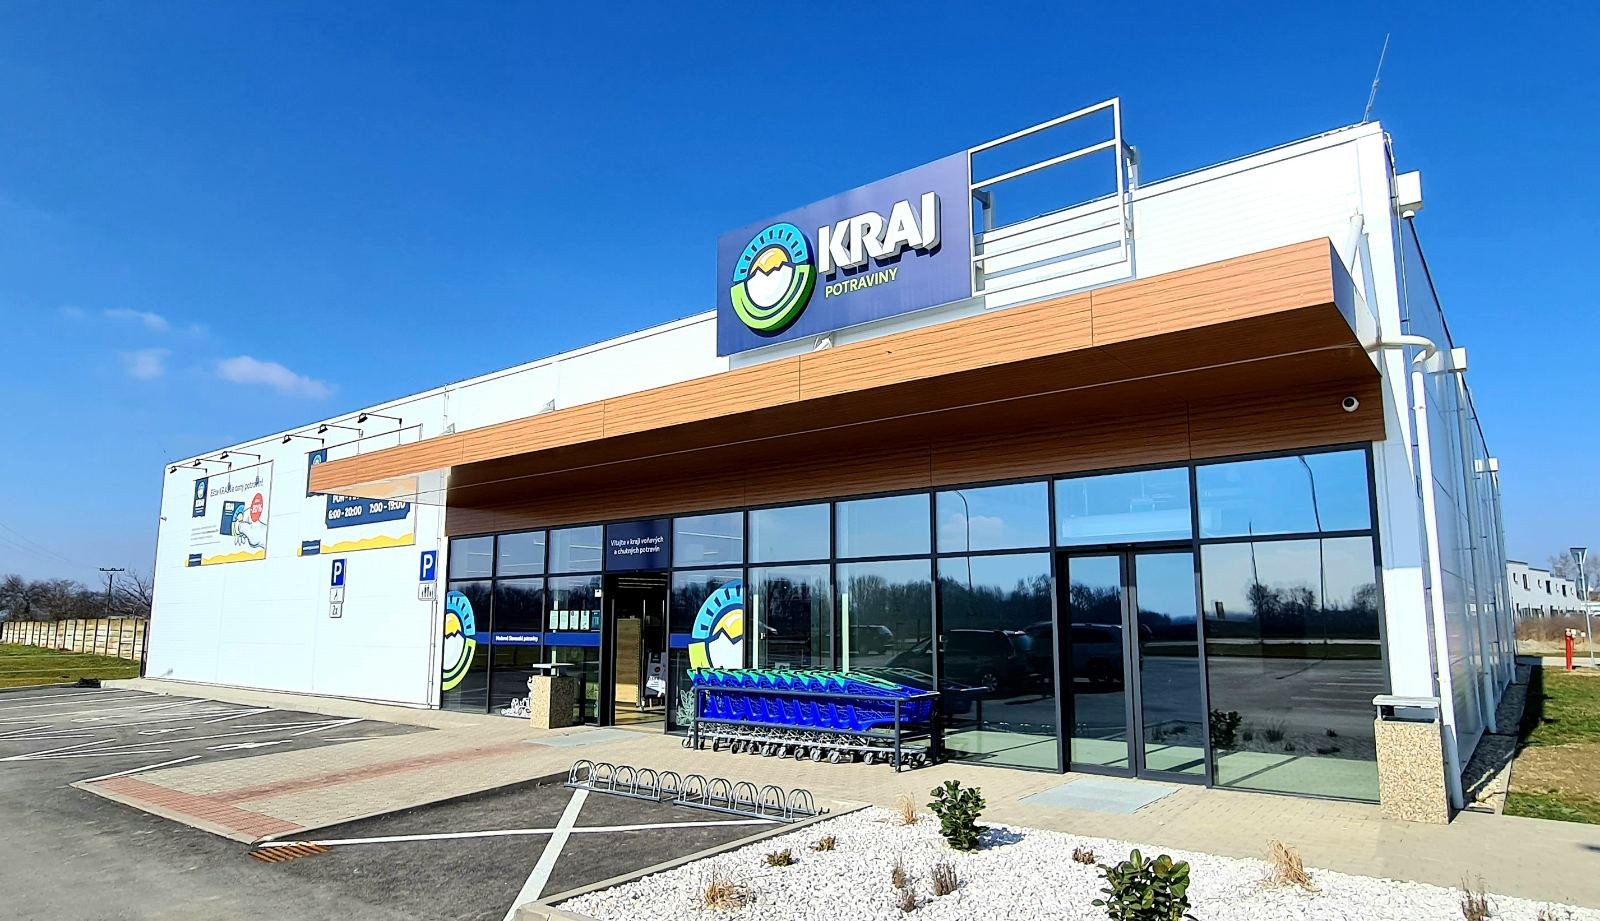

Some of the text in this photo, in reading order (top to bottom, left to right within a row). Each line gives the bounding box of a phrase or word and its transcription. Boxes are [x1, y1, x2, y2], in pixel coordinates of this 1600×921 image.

[818, 191, 940, 277] KRAJ
[825, 267, 898, 298] POTRAVINY
[344, 506, 362, 517] 20:00
[333, 562, 342, 583] P
[422, 554, 434, 578] P
